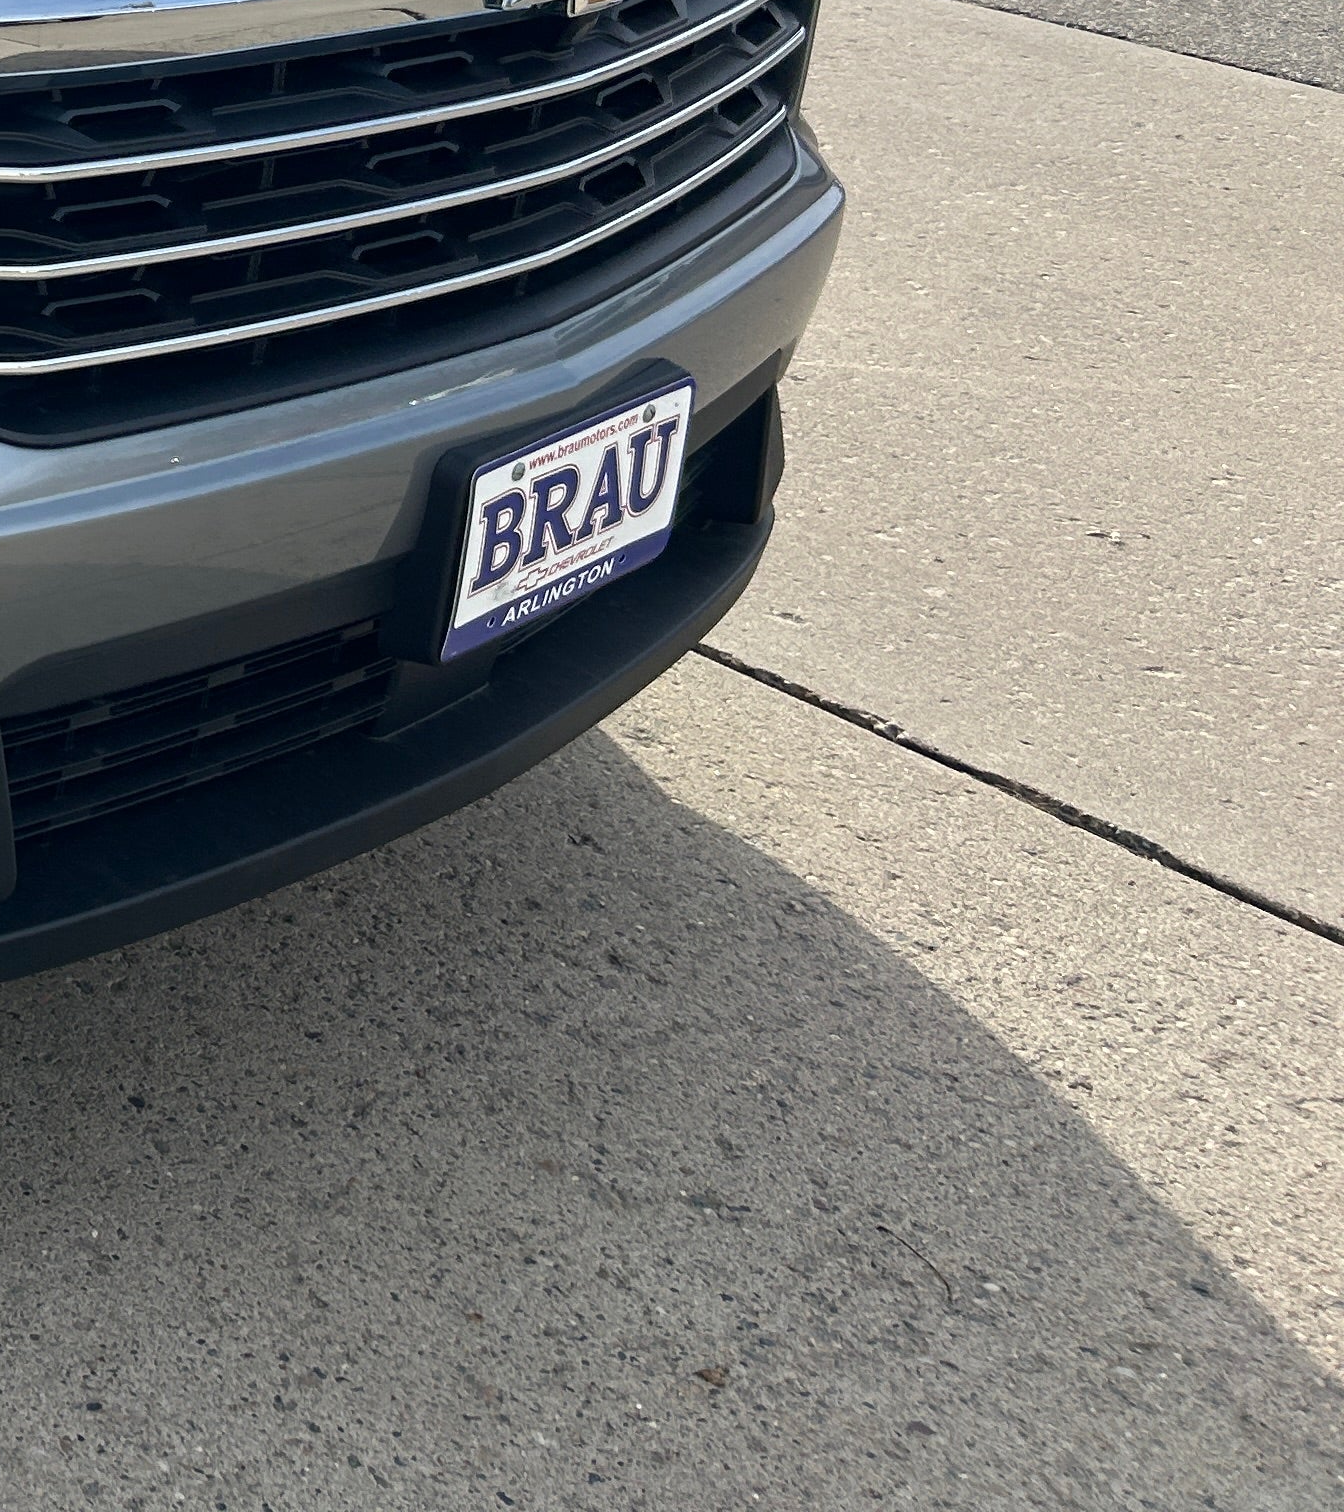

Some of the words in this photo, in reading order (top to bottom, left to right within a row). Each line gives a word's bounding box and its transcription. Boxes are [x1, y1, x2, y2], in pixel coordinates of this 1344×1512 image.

[528, 414, 639, 470] www.braumotors.com
[467, 414, 680, 599] BRAU
[546, 536, 615, 576] CHEVROLET
[501, 558, 615, 627] ARLINGTON
